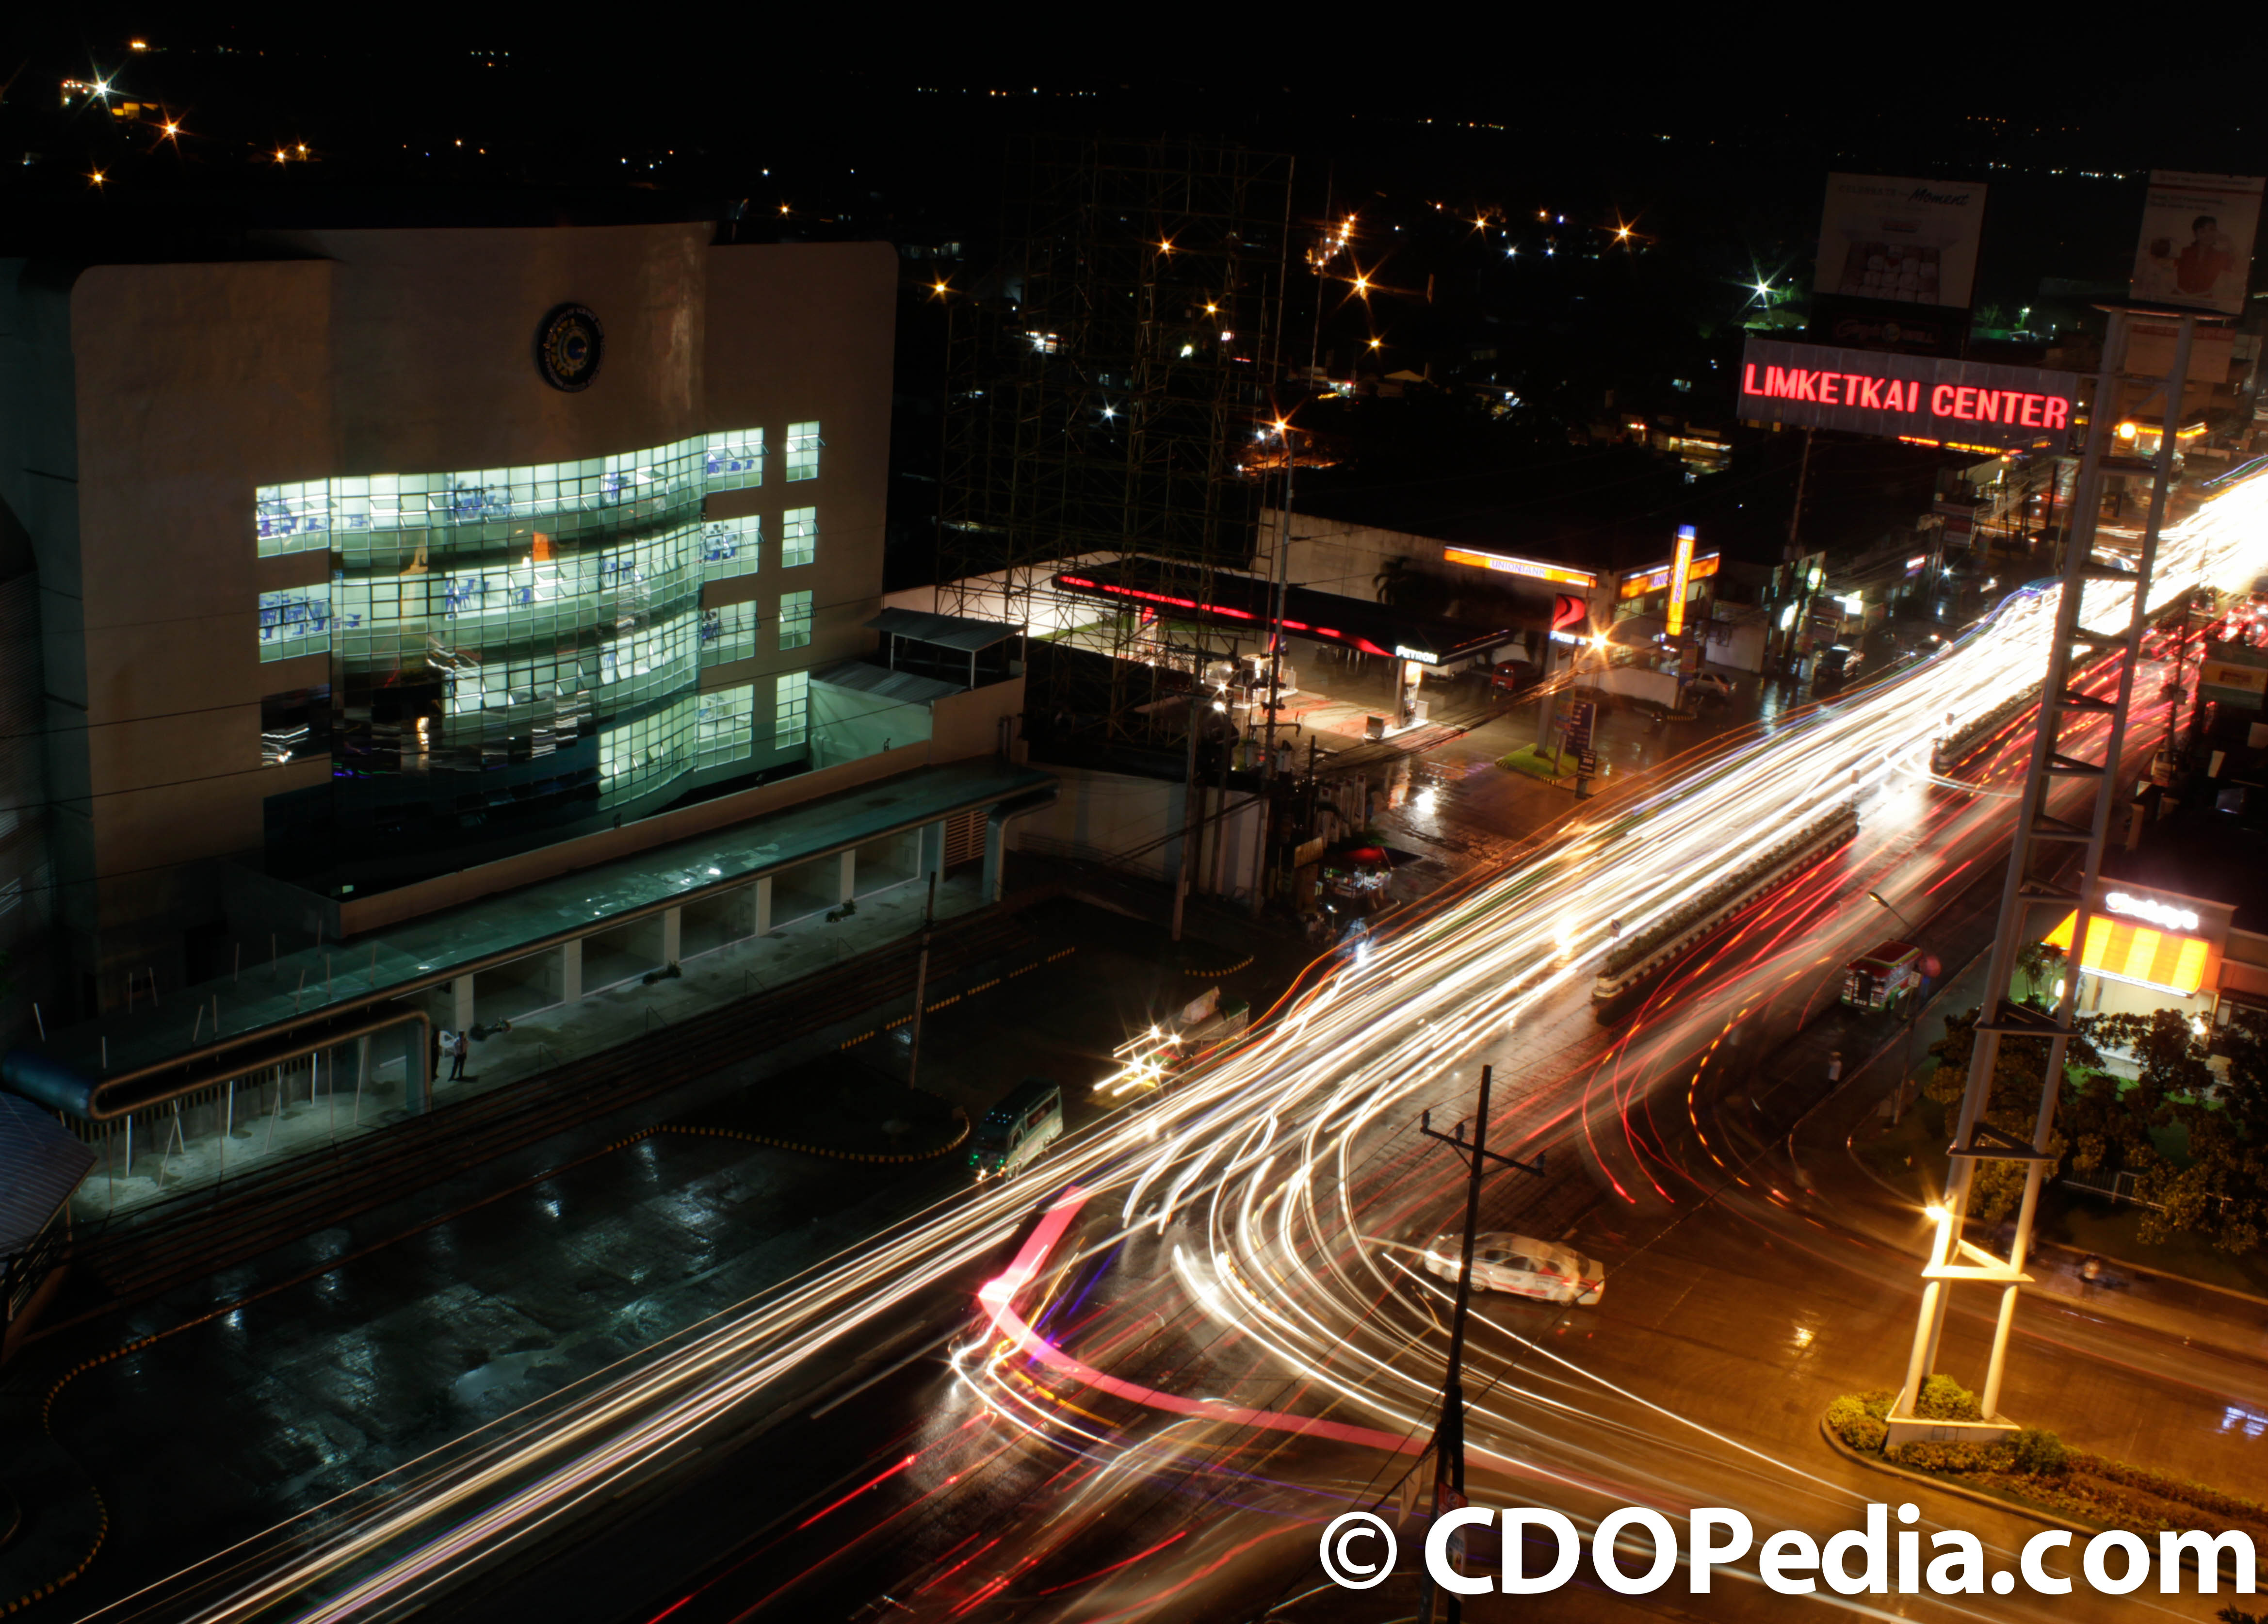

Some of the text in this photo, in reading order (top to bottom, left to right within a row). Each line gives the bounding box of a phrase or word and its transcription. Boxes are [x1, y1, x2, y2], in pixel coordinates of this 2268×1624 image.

[1908, 187, 1969, 206] Moment
[1744, 363, 2069, 430] LIMKETKAI CENTER
[1491, 560, 1546, 577] UNIONBANK
[1674, 542, 1688, 603] UNIONBANK
[1395, 645, 1438, 664] PETRON
